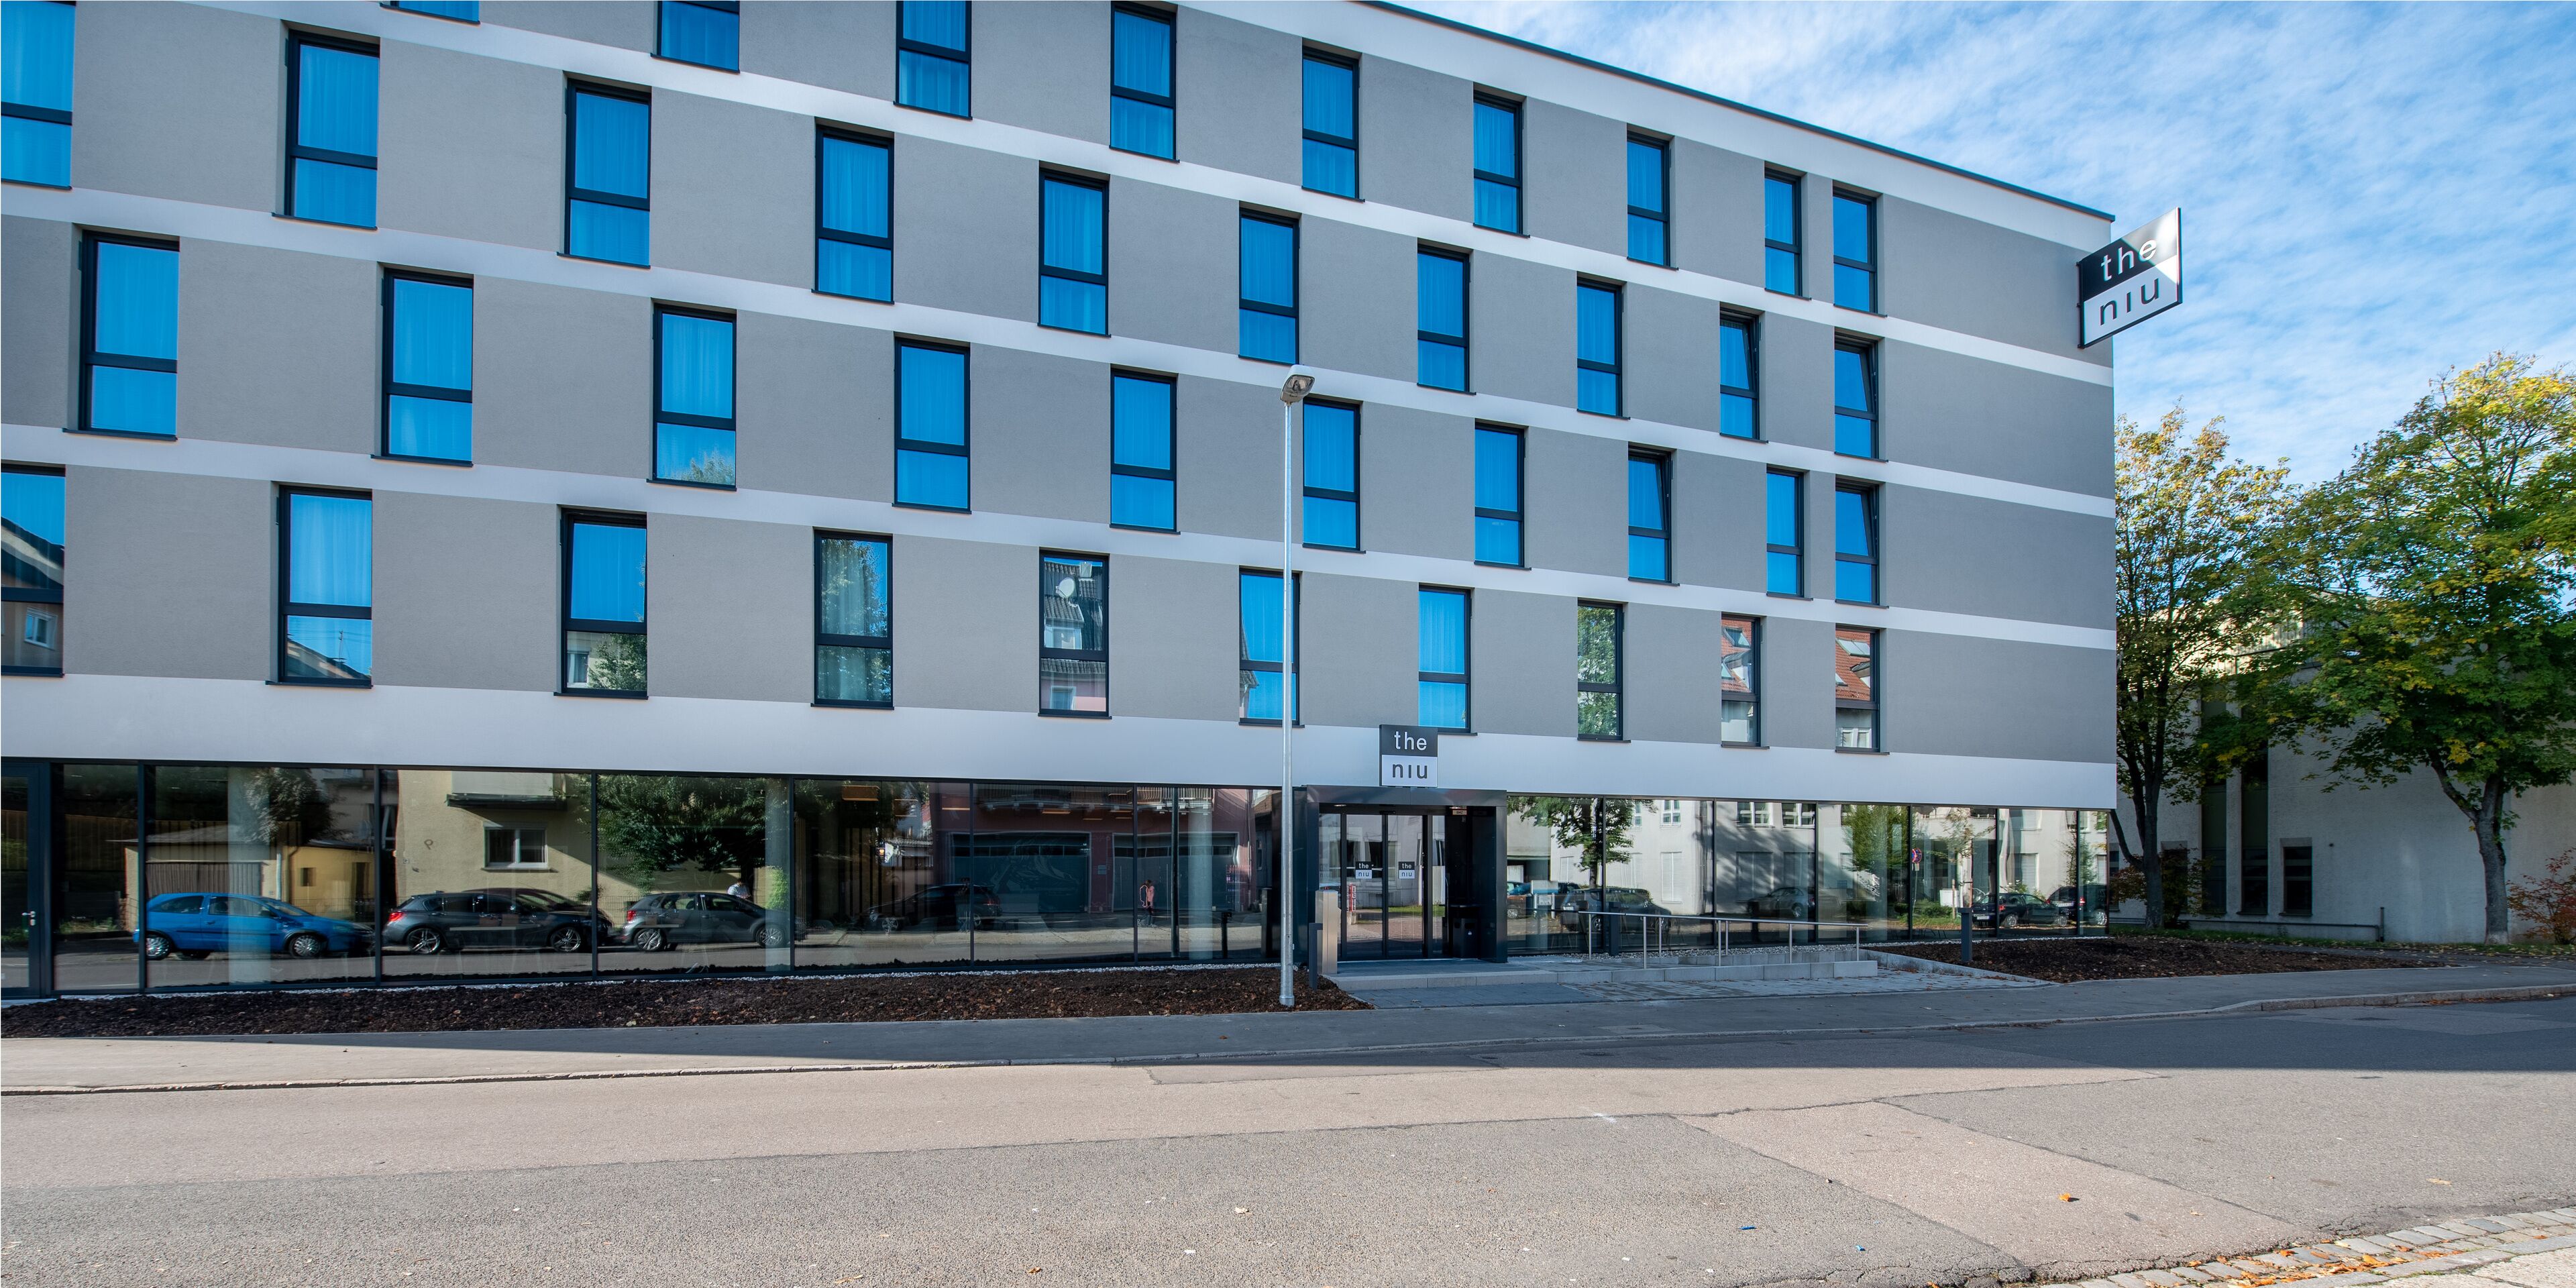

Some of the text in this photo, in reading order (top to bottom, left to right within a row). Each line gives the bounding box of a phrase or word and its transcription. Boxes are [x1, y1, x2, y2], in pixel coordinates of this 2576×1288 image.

[2100, 239, 2157, 281] the
[2100, 278, 2159, 326] niu
[1394, 731, 1427, 751] the
[1392, 763, 1428, 779] niu
